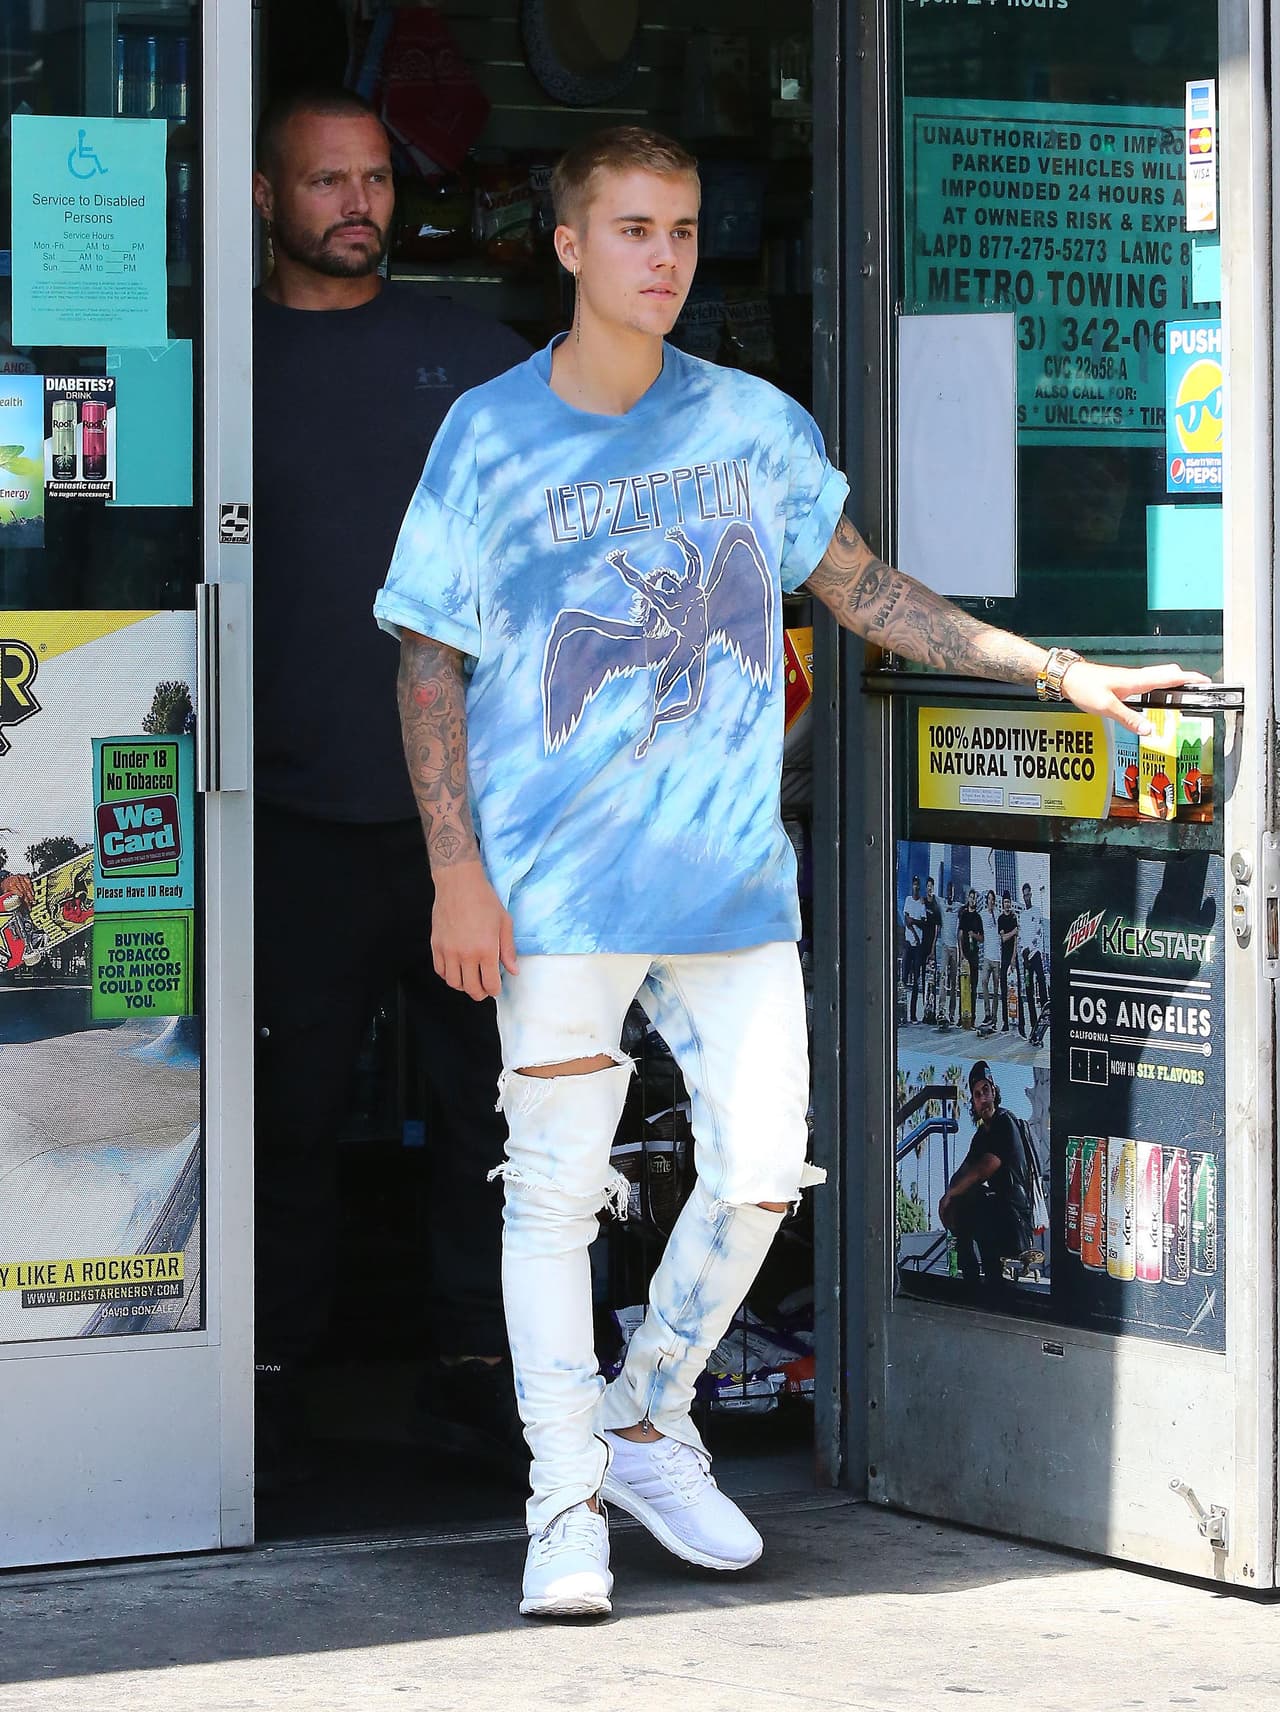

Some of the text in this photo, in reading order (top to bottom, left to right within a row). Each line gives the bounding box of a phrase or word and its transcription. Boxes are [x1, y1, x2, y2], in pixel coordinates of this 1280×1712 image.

[923, 127, 1185, 155] UNAUTHORIZED OR IMPRO
[953, 153, 1186, 181] PARKED VEHICLES WILL
[1193, 167, 1211, 180] VISA
[32, 193, 145, 207] Service to Disabled
[942, 179, 1060, 200] IMPOUNDED
[1069, 184, 1090, 201] 24
[1099, 186, 1165, 205] HOURS
[64, 211, 113, 224] Persons
[943, 206, 967, 225] AT
[974, 208, 1058, 228] OWNERS
[1067, 212, 1112, 230] RISK
[1121, 214, 1133, 231] &
[63, 232, 114, 240] Service Hours
[102, 243, 109, 251] to
[132, 243, 145, 251] PM
[920, 233, 971, 257] LAPD
[979, 235, 1107, 263] 877-275-5273
[1121, 241, 1173, 265] LAMC
[79, 253, 92, 261] AM
[79, 264, 92, 272] AM
[96, 264, 103, 272] to
[123, 264, 136, 272] PM
[928, 267, 1034, 305] METRO
[1047, 272, 1167, 309] TOWING
[1044, 355, 1071, 380] CVC
[46, 378, 114, 391] DIABETES?
[1034, 385, 1069, 399] ALSO
[1073, 386, 1105, 400] CALL
[66, 391, 92, 400] DRINK
[1045, 405, 1122, 424] UNLOCKS
[1186, 468, 1222, 484] PEPSI
[48, 481, 87, 491] Fantastic
[929, 726, 1094, 754] 100% ADDITIVE-FREE
[113, 750, 167, 769] Under 18
[930, 752, 1095, 781] NATURAL TOBACCO
[107, 772, 173, 790] No Tobacco
[113, 803, 163, 830] We
[103, 824, 175, 856] Card
[96, 884, 183, 899] Please Have ID Ready
[115, 932, 164, 946] BUYING
[1101, 916, 1216, 963] KICKSTART
[108, 947, 170, 963] TOBACCO
[98, 962, 181, 979] FOR MINORS
[100, 977, 180, 994] COULD COST
[125, 995, 156, 1009] YOU.
[1069, 996, 1211, 1037] LOS ANGELES
[1069, 1029, 1109, 1043] CALIFORNIA
[1110, 1060, 1205, 1086] NOW IN SIX FLAVORS
[1176, 1160, 1188, 1278] KICKSTART
[1203, 1166, 1214, 1270] KICKSTART
[17, 1264, 57, 1286] LIKE
[64, 1264, 75, 1283] A
[82, 1257, 179, 1282] ROCKSTAR
[26, 1283, 179, 1305] WWW.ROCKSTARENERGY.COM
[101, 1306, 129, 1318] DAVID
